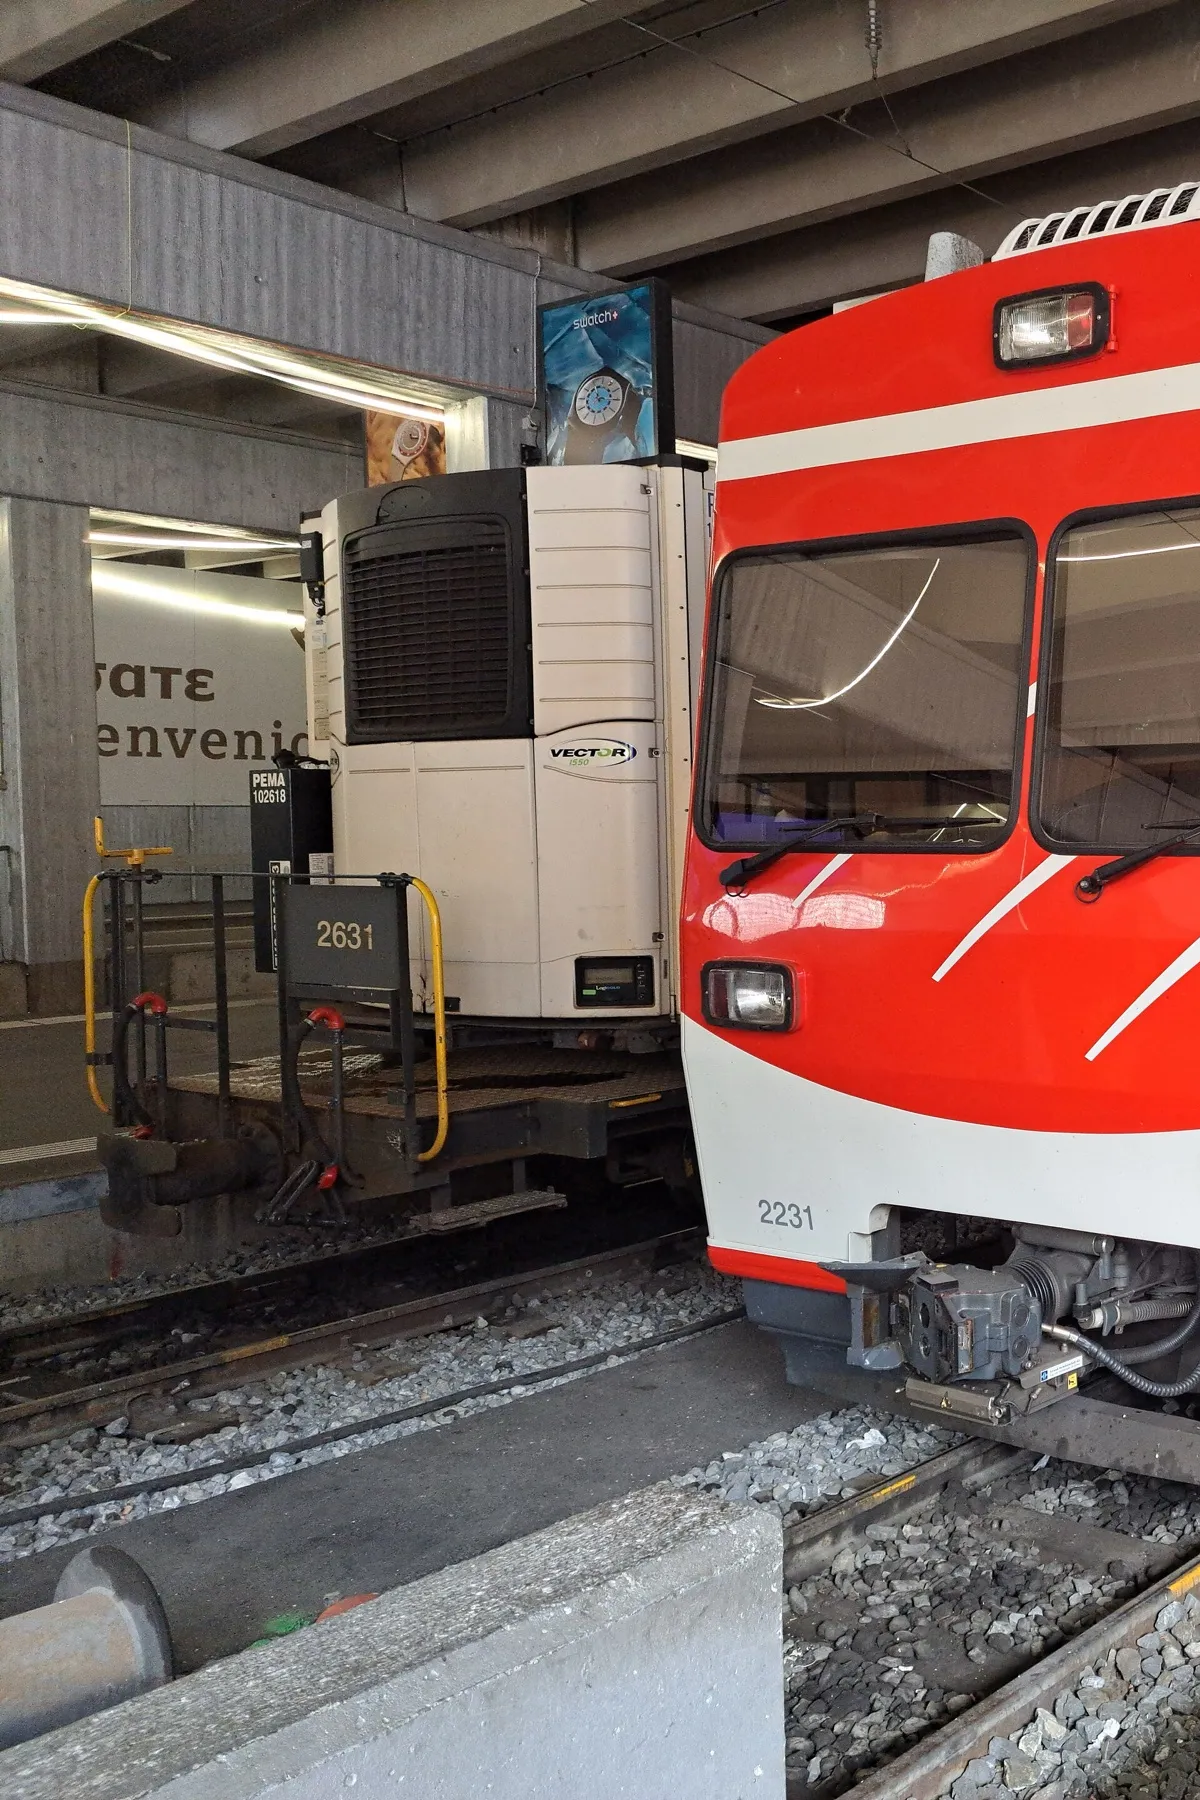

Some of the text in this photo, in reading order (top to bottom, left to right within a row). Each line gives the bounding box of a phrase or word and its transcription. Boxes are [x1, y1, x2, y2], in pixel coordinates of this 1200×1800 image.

[573, 310, 612, 330] swatch
[550, 748, 626, 758] VECTOR
[252, 772, 286, 788] PEMA
[253, 788, 286, 804] 102618
[317, 920, 373, 950] 2631
[758, 1199, 814, 1231] 2231
